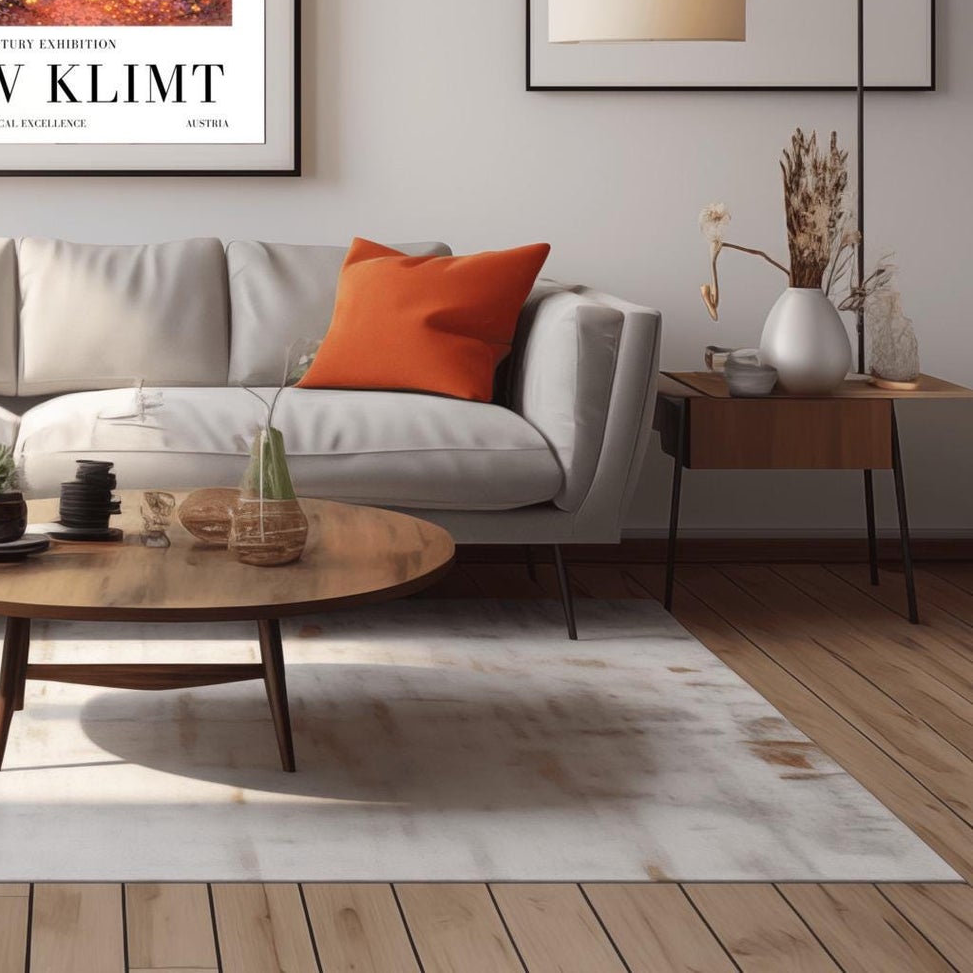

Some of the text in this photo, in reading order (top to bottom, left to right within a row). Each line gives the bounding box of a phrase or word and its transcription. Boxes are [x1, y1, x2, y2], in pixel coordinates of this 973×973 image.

[39, 39, 117, 49] EXHIBITION
[46, 63, 225, 104] KLIMT
[21, 119, 87, 128] EXCELLENCE
[186, 119, 229, 128] AUSTRIA
